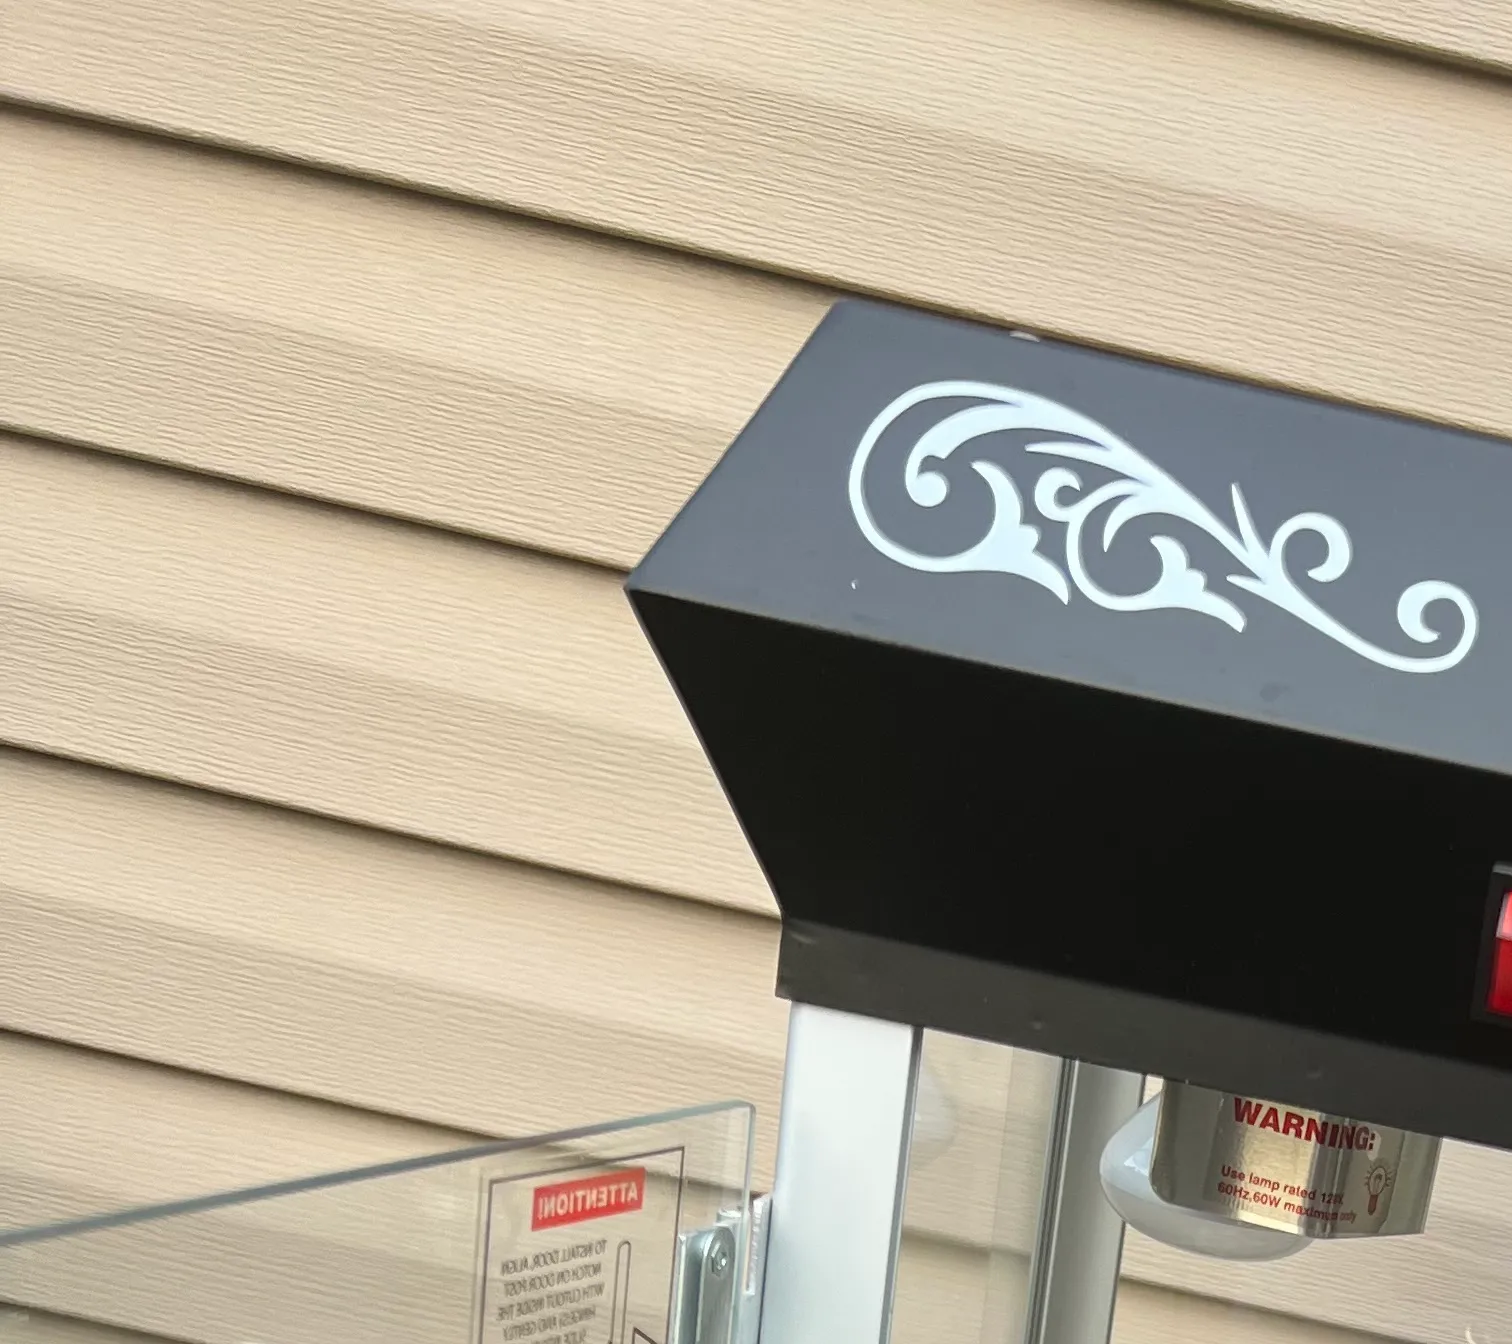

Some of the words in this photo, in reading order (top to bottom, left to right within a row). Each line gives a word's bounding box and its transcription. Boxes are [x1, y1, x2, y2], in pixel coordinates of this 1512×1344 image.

[1233, 1097, 1376, 1152] WARNING:
[1221, 1165, 1245, 1182] Use
[1249, 1170, 1280, 1192] lamp
[1283, 1183, 1317, 1200] rated
